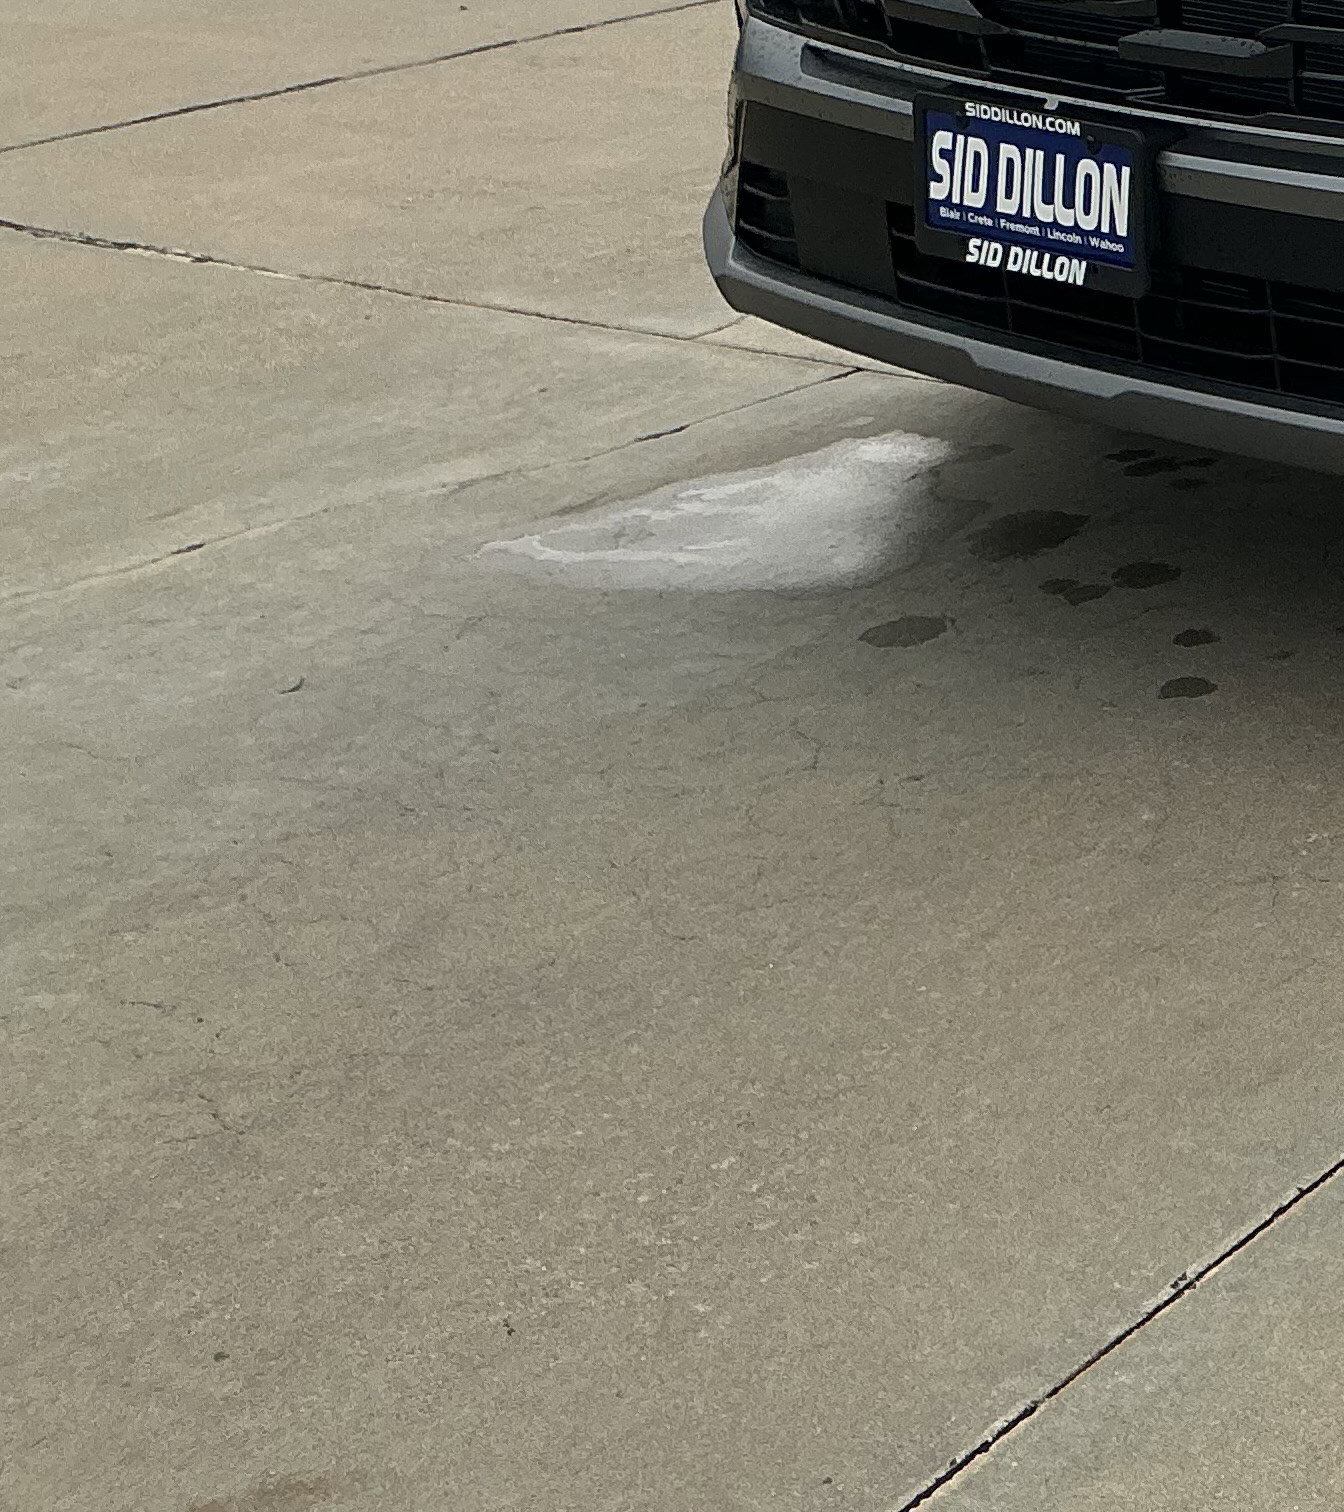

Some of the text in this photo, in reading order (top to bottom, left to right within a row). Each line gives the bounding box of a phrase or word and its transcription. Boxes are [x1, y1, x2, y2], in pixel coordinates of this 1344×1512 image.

[964, 101, 1081, 137] SIDDILLON.COM
[928, 130, 1131, 238] SID DILLON
[967, 212, 993, 227] Crete
[999, 217, 1041, 237] Fremont
[1046, 227, 1083, 245] Lincoln
[1088, 234, 1125, 253] Wahoo
[965, 237, 1087, 286] SID DILLON
